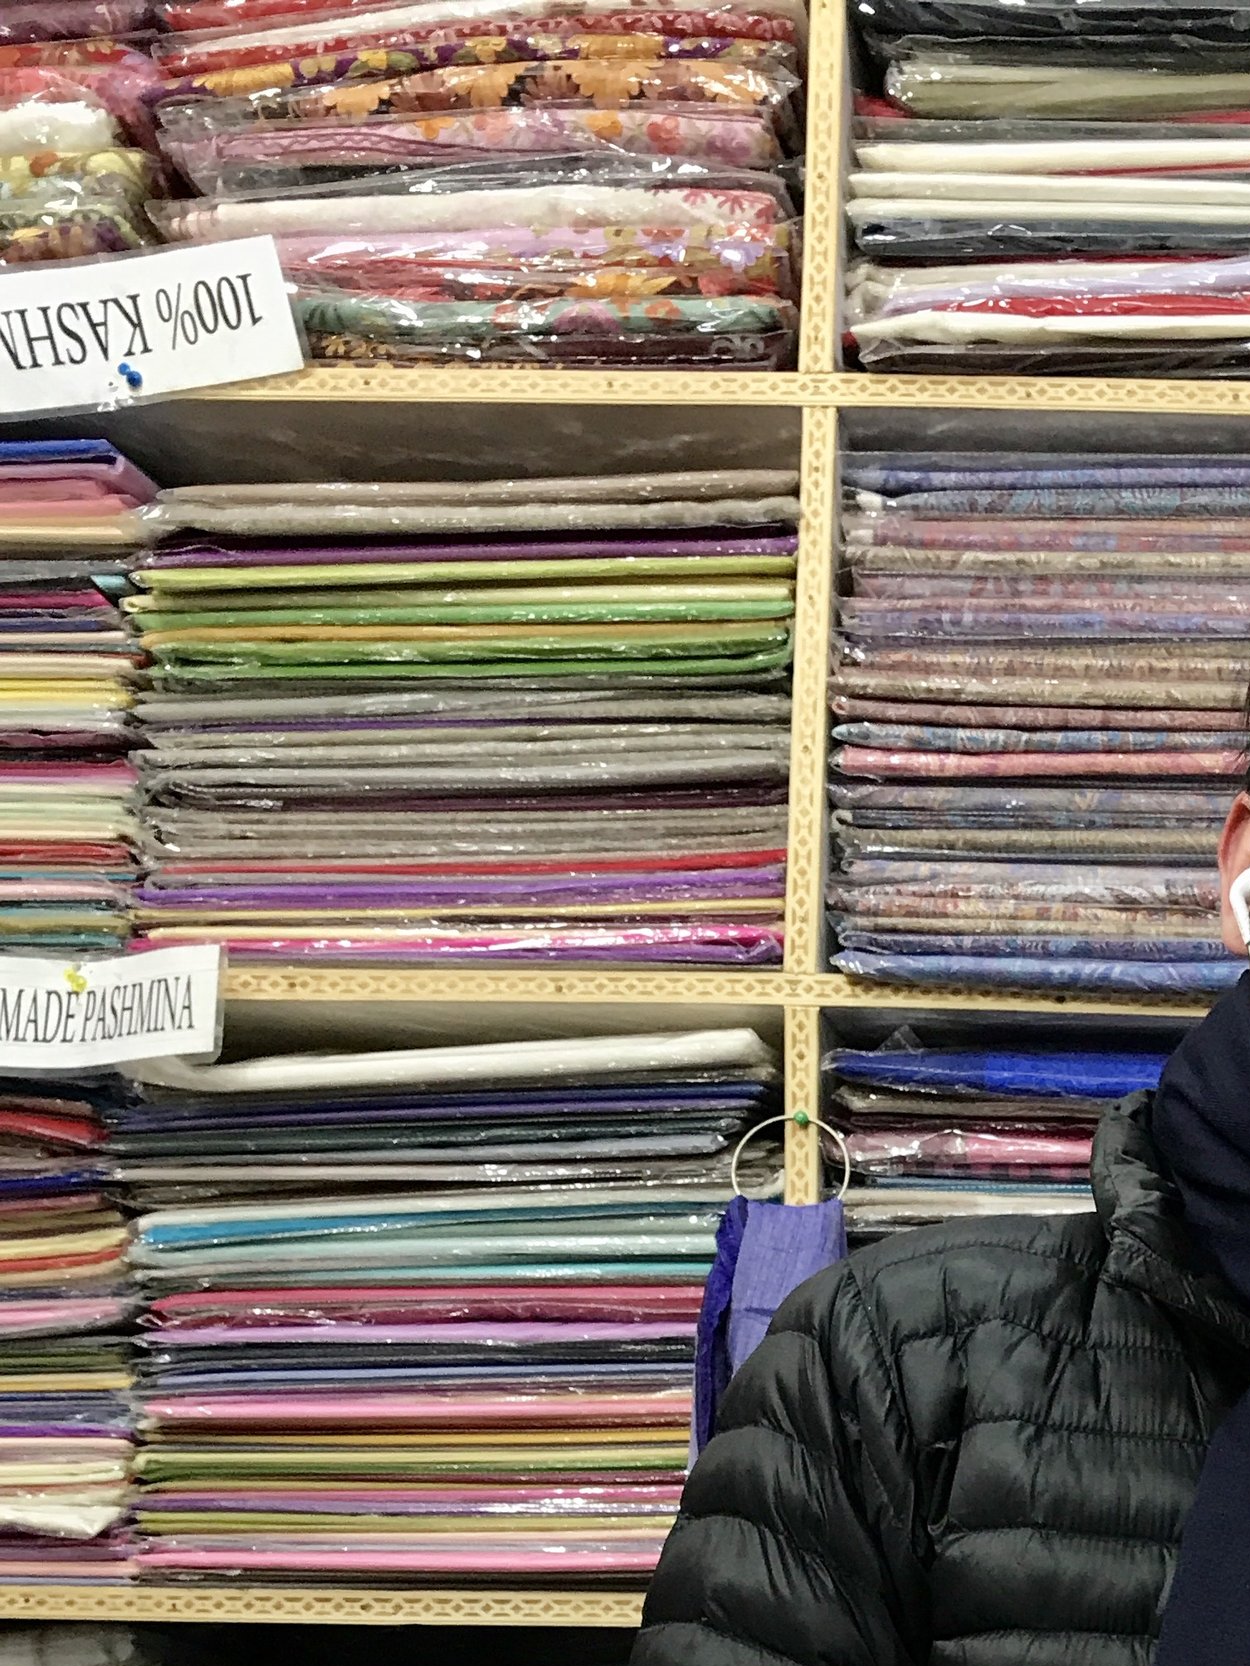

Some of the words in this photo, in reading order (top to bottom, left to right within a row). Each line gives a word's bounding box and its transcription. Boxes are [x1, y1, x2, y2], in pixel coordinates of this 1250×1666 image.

[155, 273, 263, 350] 100%
[0, 988, 80, 1043] MADE
[80, 974, 195, 1042] PASHMINA
